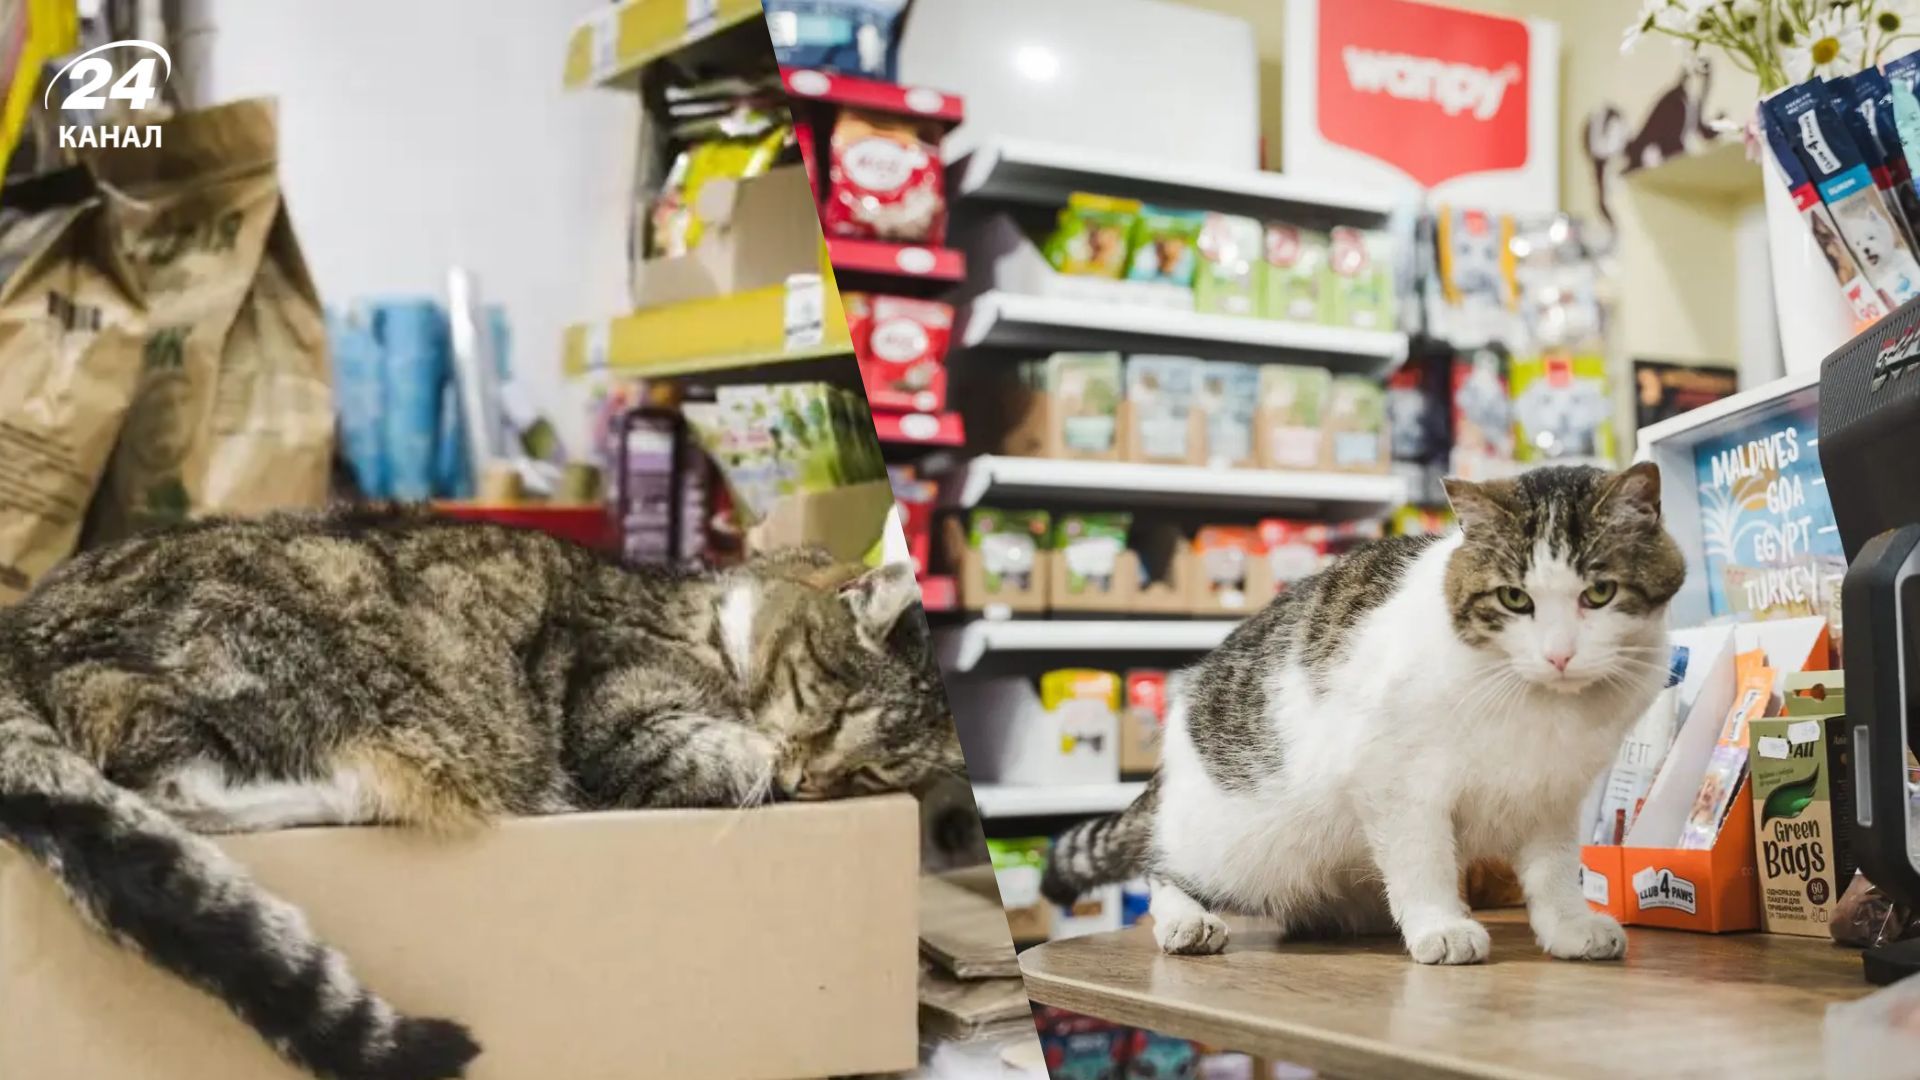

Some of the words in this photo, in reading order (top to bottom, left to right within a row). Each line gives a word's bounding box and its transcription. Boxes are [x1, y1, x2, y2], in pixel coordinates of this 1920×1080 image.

[1342, 45, 1509, 121] wanpy
[1766, 475, 1804, 514] GOA
[1753, 515, 1813, 562] EGYPT
[1743, 562, 1818, 611] TURKEY
[1774, 820, 1820, 843] Green
[1763, 841, 1825, 881] Bags
[1660, 872, 1670, 899] 4
[1671, 886, 1694, 904] PAWS
[1811, 882, 1823, 894] 60
